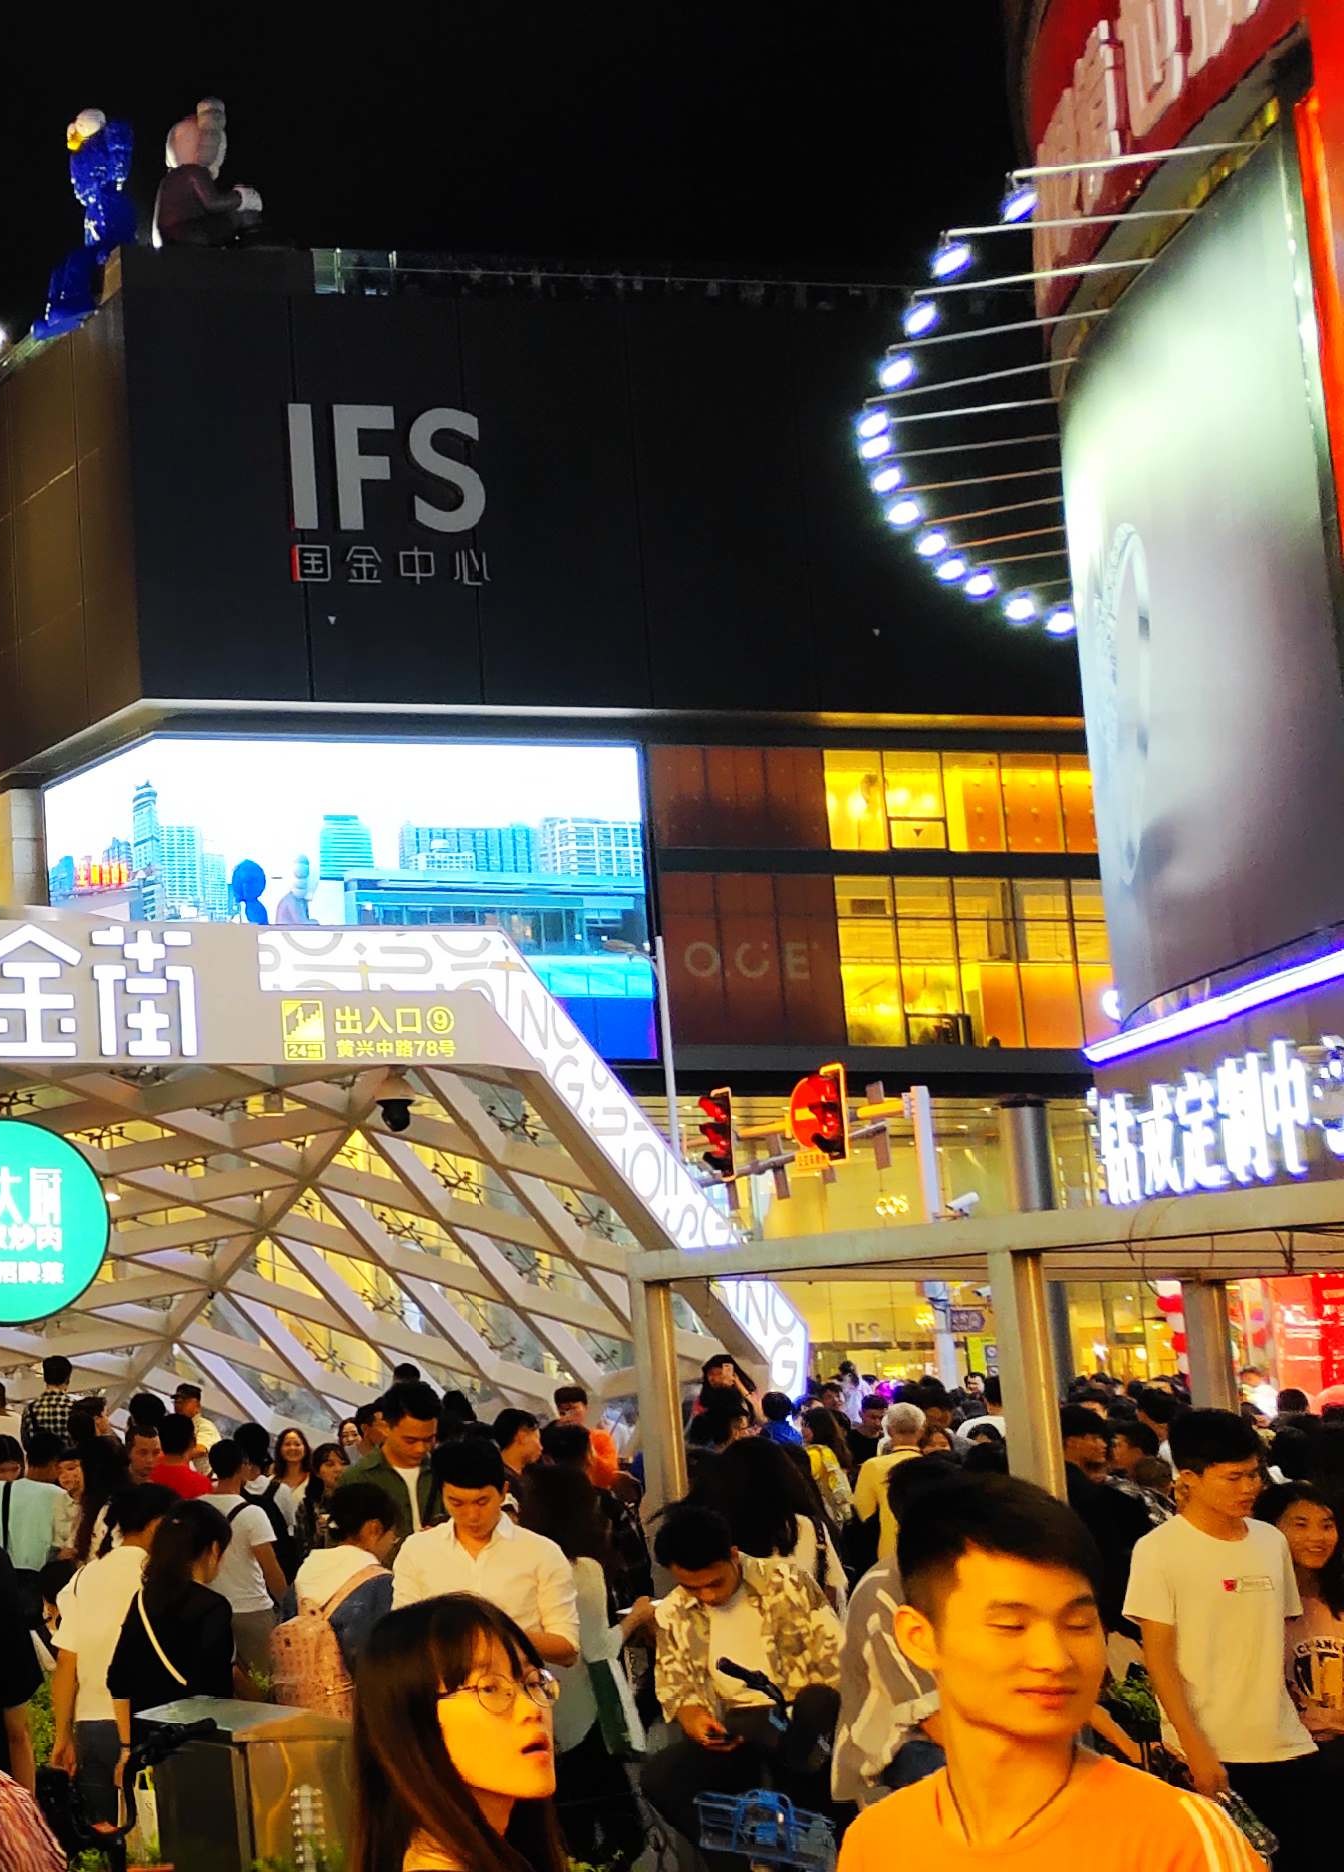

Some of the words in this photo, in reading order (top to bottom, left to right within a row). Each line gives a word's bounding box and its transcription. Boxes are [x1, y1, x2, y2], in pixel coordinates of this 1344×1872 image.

[287, 403, 487, 534] IFS
[291, 544, 491, 586] 国金中心
[336, 1039, 457, 1058] 黄兴中路78号
